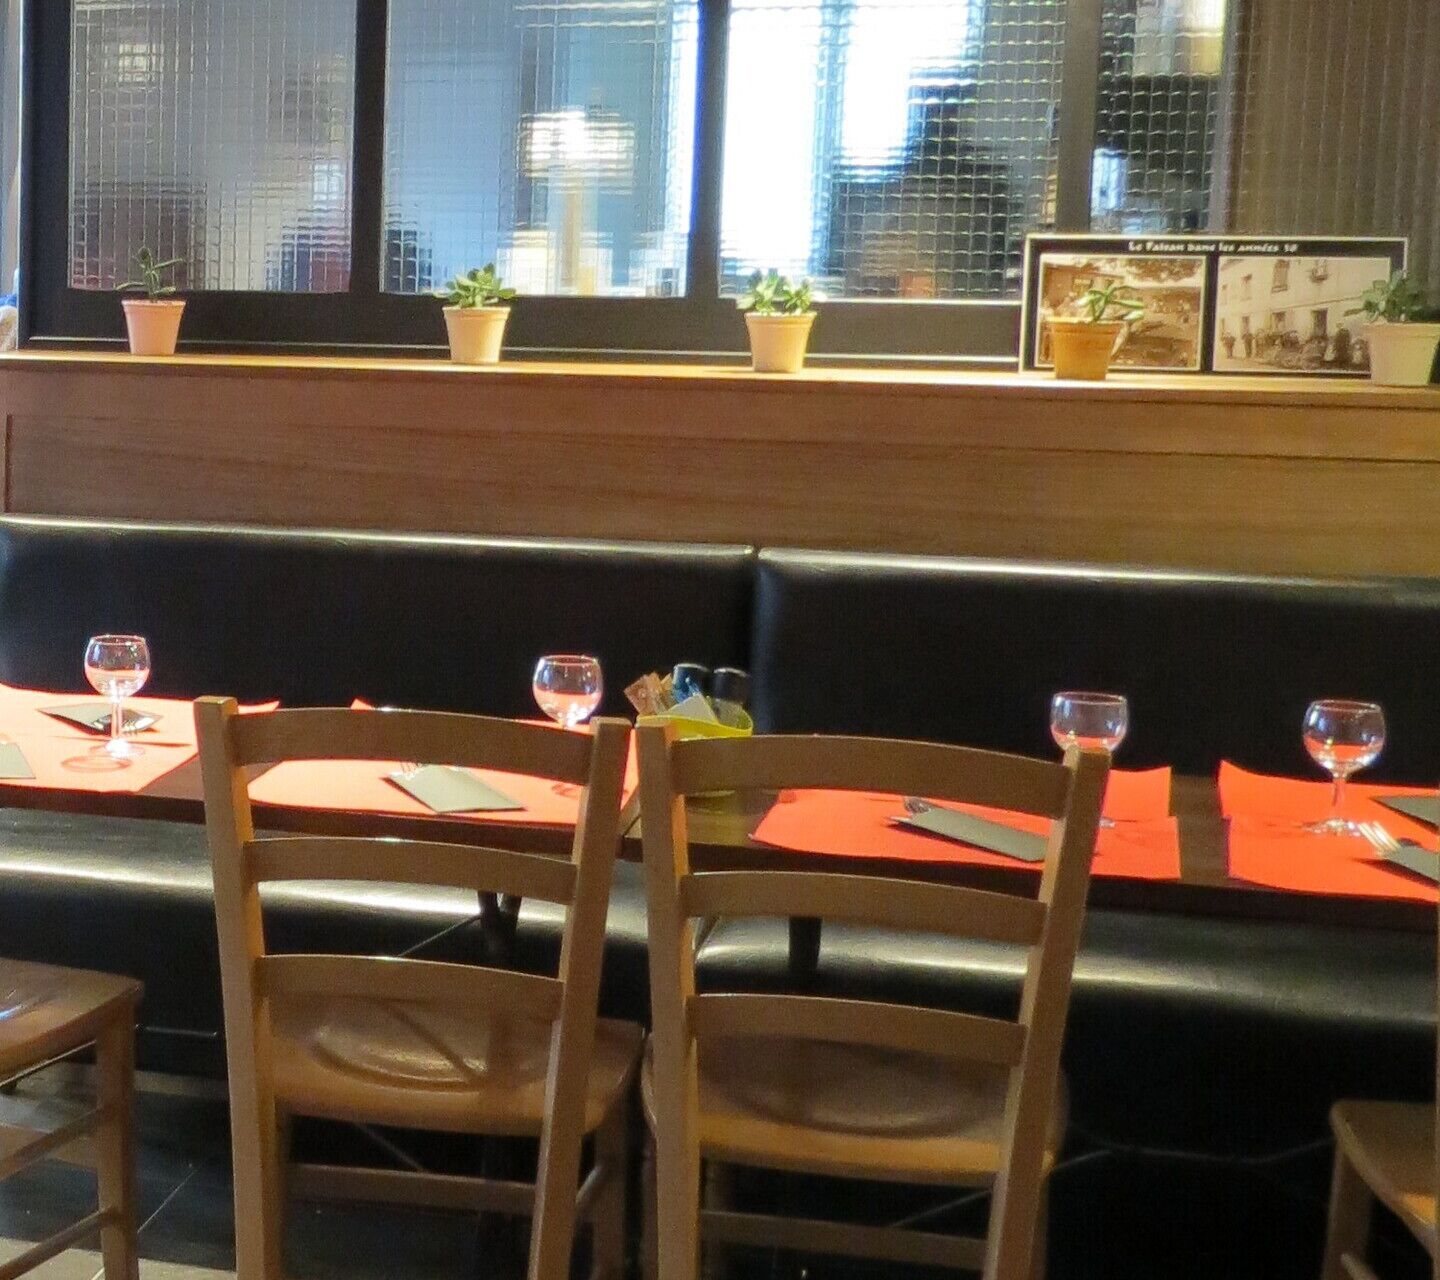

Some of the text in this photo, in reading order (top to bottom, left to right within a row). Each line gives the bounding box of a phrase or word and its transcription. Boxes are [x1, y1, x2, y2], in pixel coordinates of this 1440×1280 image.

[1128, 241, 1143, 252] Le
[1186, 242, 1216, 252] dans
[1218, 241, 1234, 252] les
